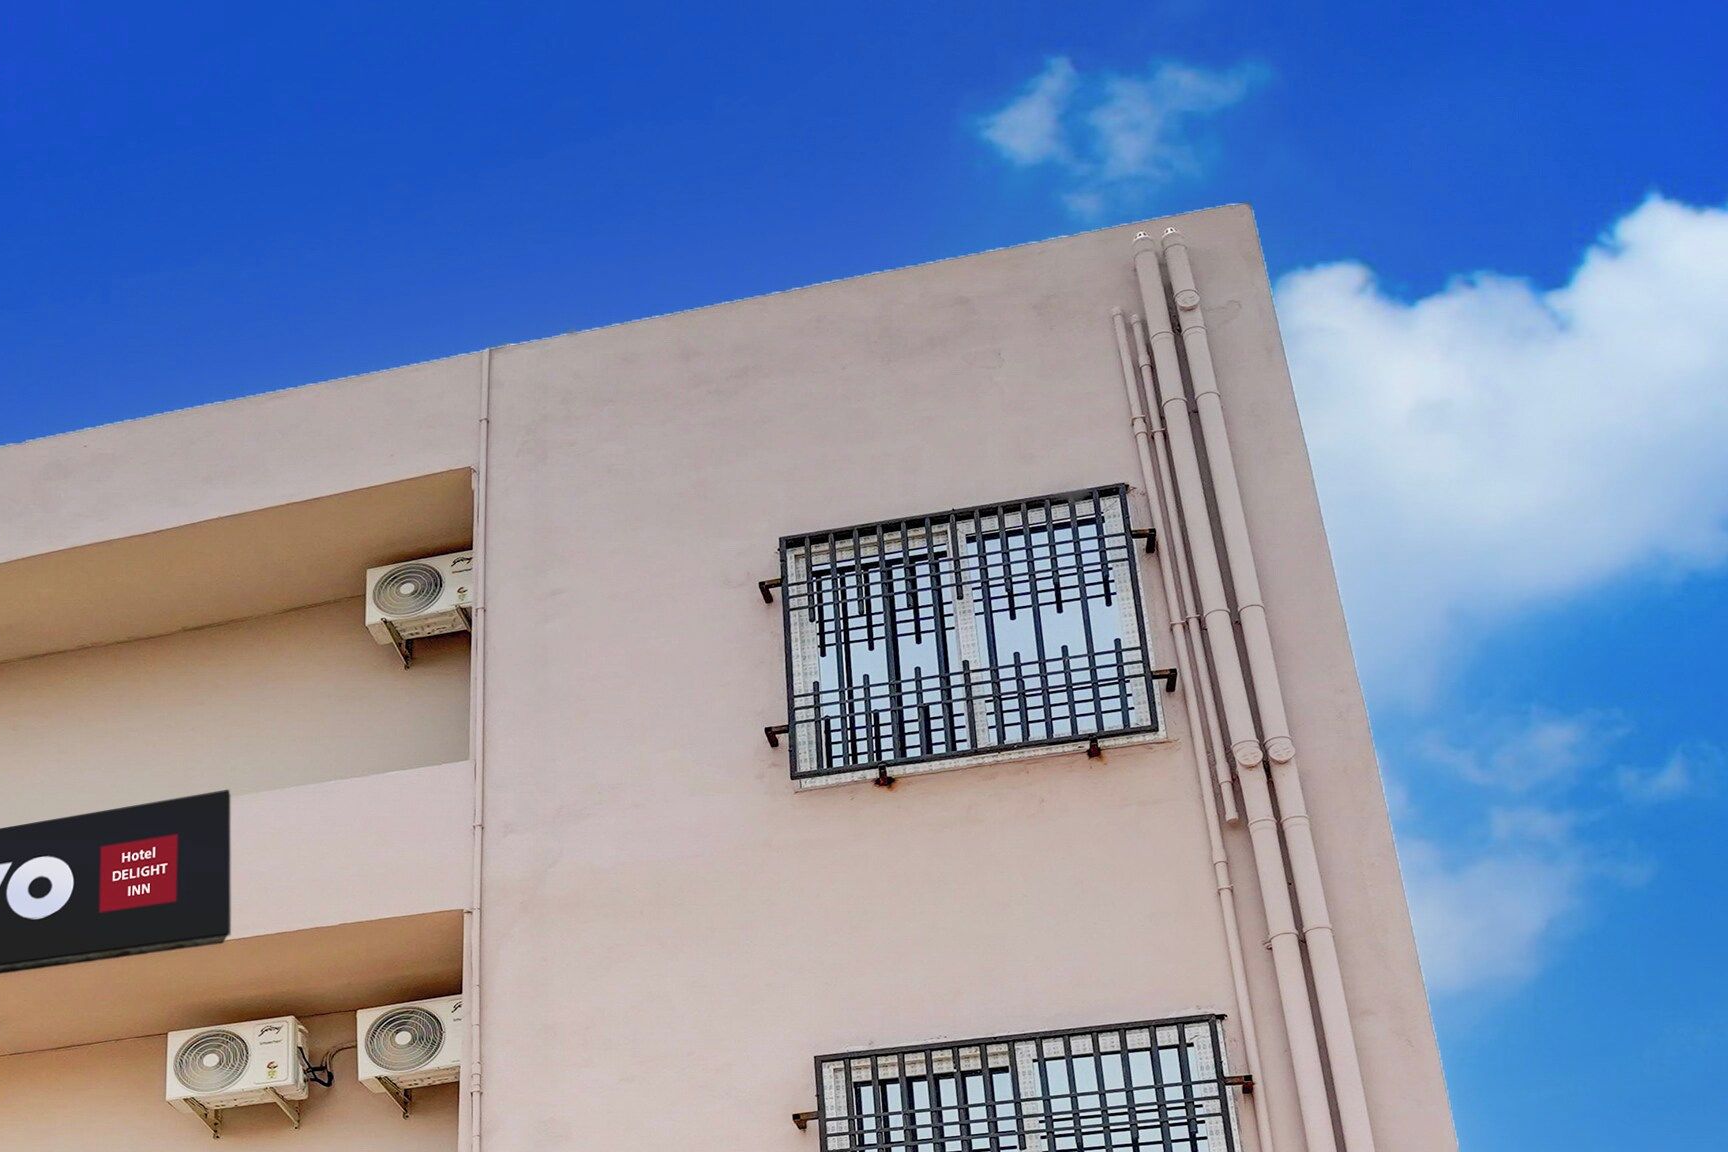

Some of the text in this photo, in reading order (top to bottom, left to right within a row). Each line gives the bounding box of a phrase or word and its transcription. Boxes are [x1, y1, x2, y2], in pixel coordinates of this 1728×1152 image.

[121, 846, 157, 863] Hotel
[112, 863, 168, 882] DELIGHT
[127, 883, 151, 897] INN
